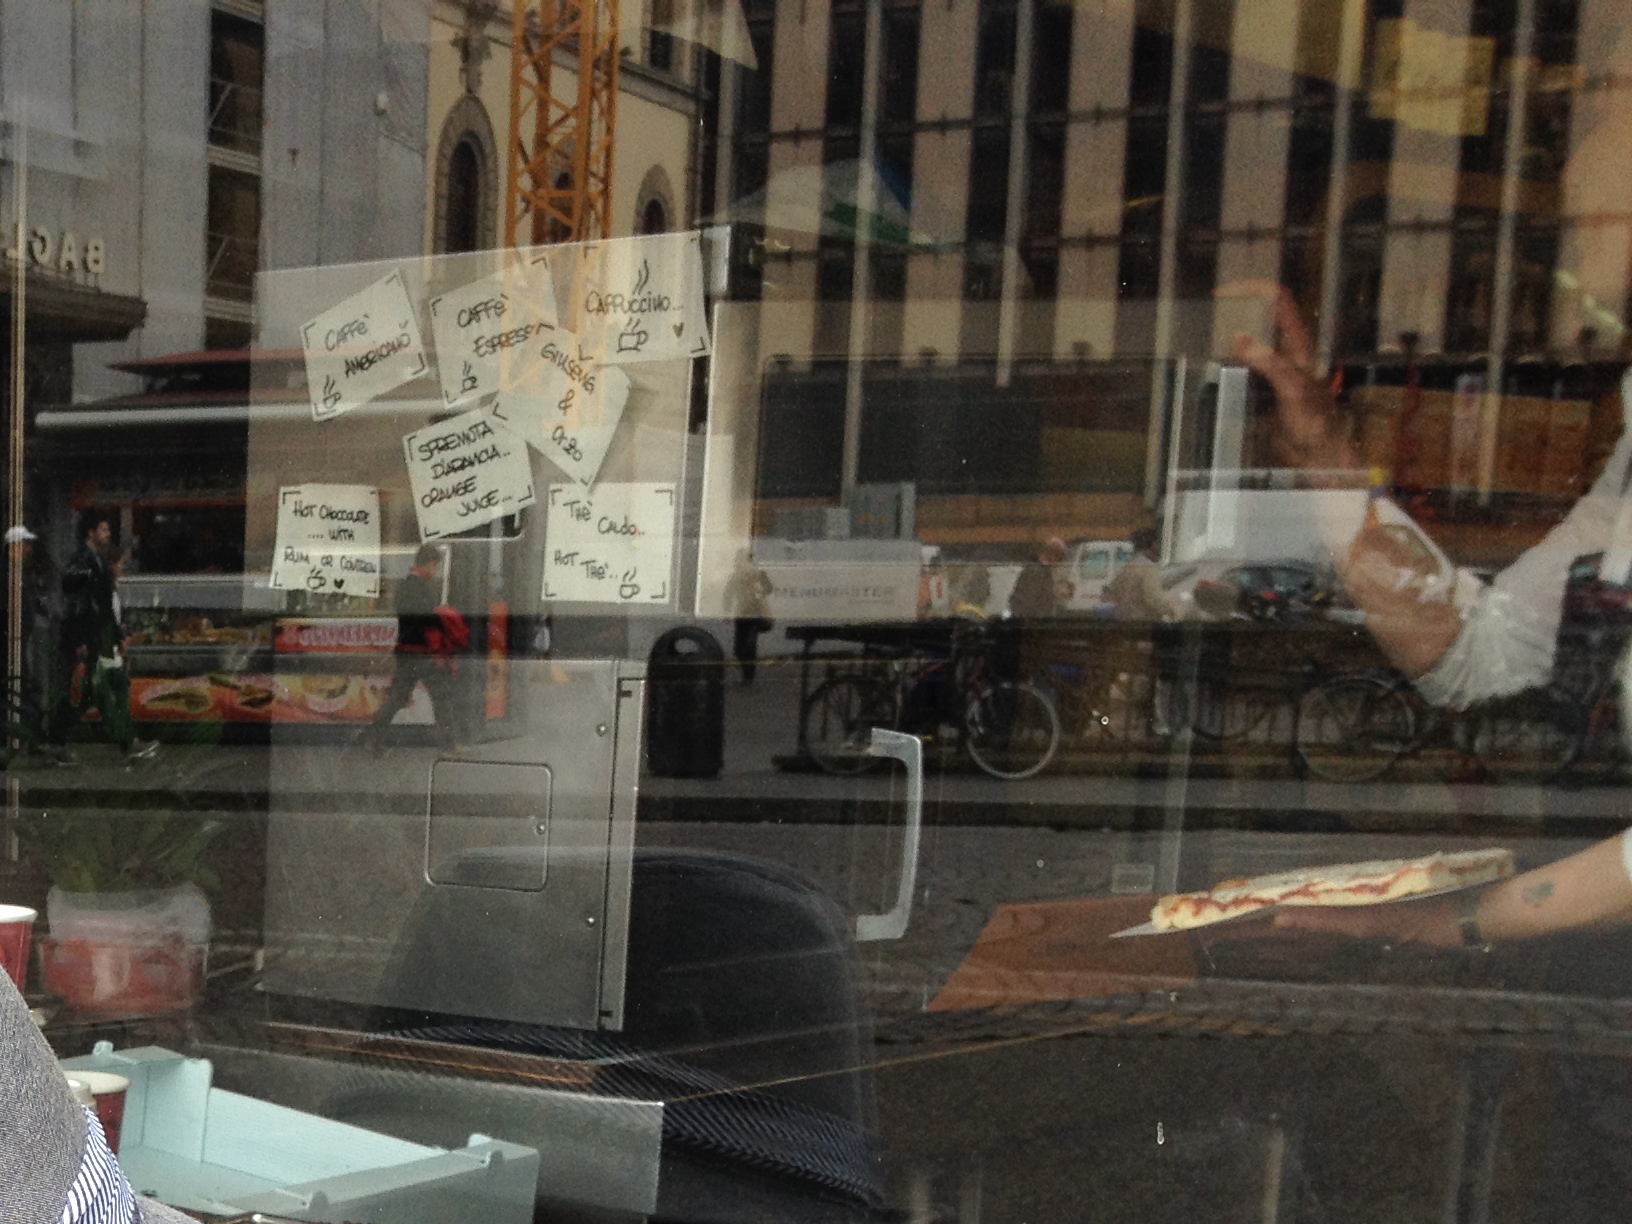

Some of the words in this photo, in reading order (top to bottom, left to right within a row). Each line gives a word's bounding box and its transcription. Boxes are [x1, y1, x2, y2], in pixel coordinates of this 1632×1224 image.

[558, 389, 575, 416] &
[418, 420, 494, 461] SPREMUTA
[421, 475, 477, 508] ORANGE
[293, 501, 316, 517] HOT
[284, 546, 309, 564] RUM
[554, 550, 580, 566] HOT
